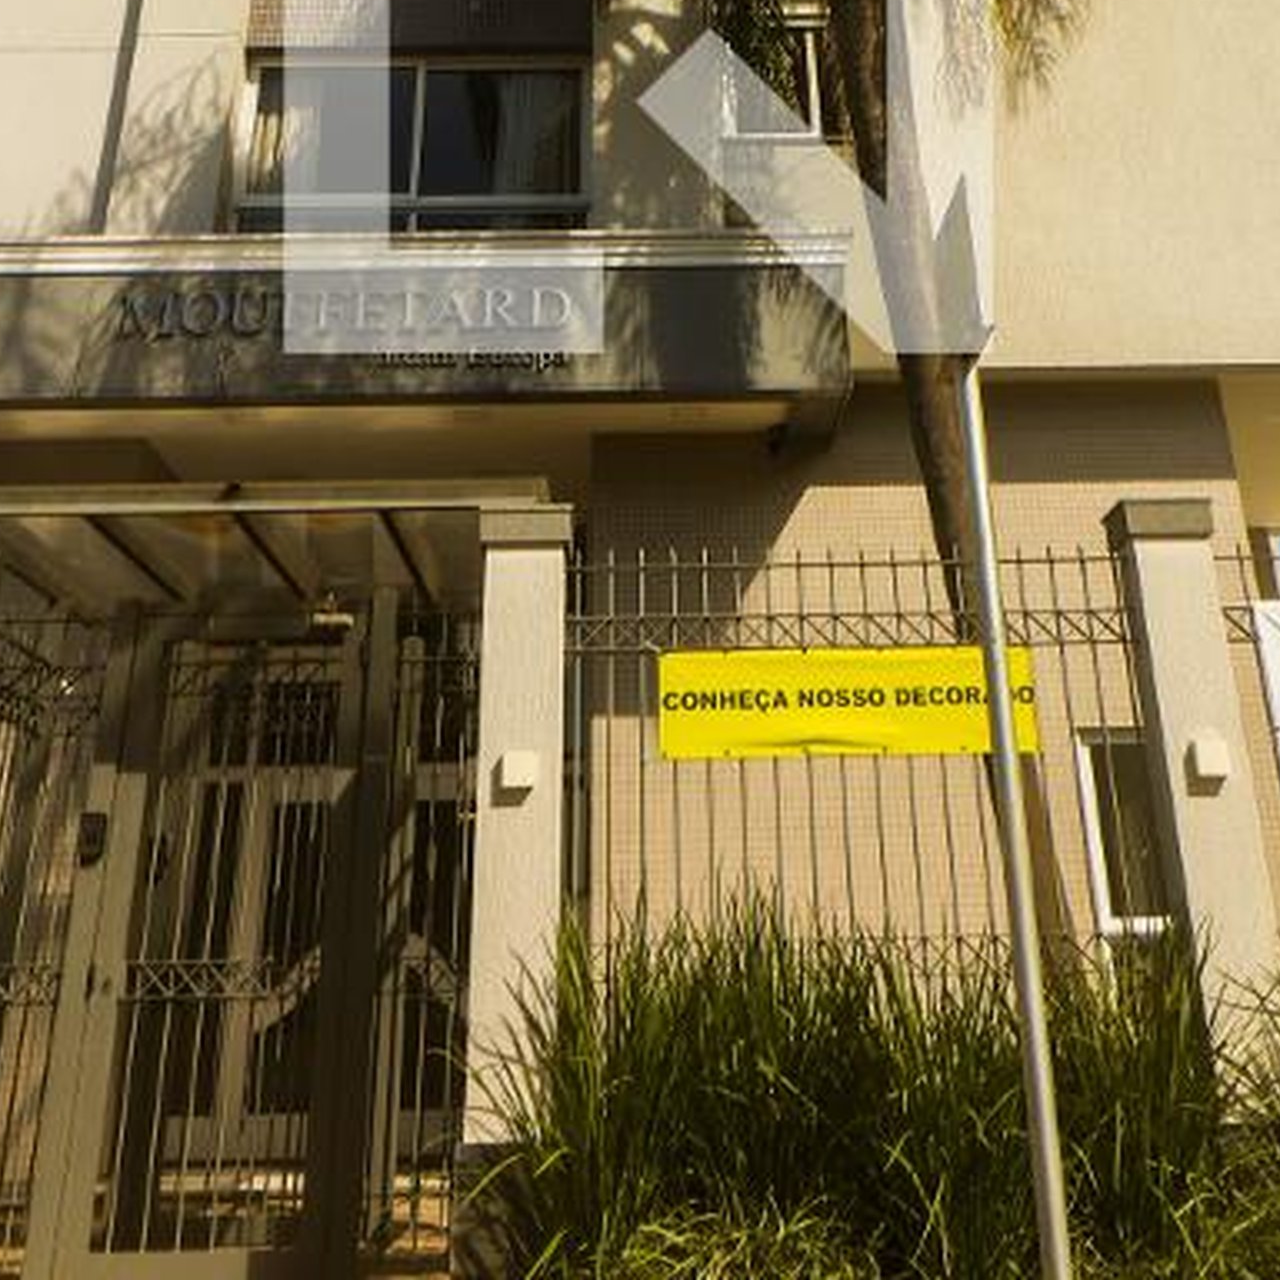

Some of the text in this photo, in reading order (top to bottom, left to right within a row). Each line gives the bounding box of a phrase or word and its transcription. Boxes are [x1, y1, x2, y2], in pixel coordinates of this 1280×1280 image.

[662, 685, 1035, 713] CONHEÇA NOSSO DECORO
